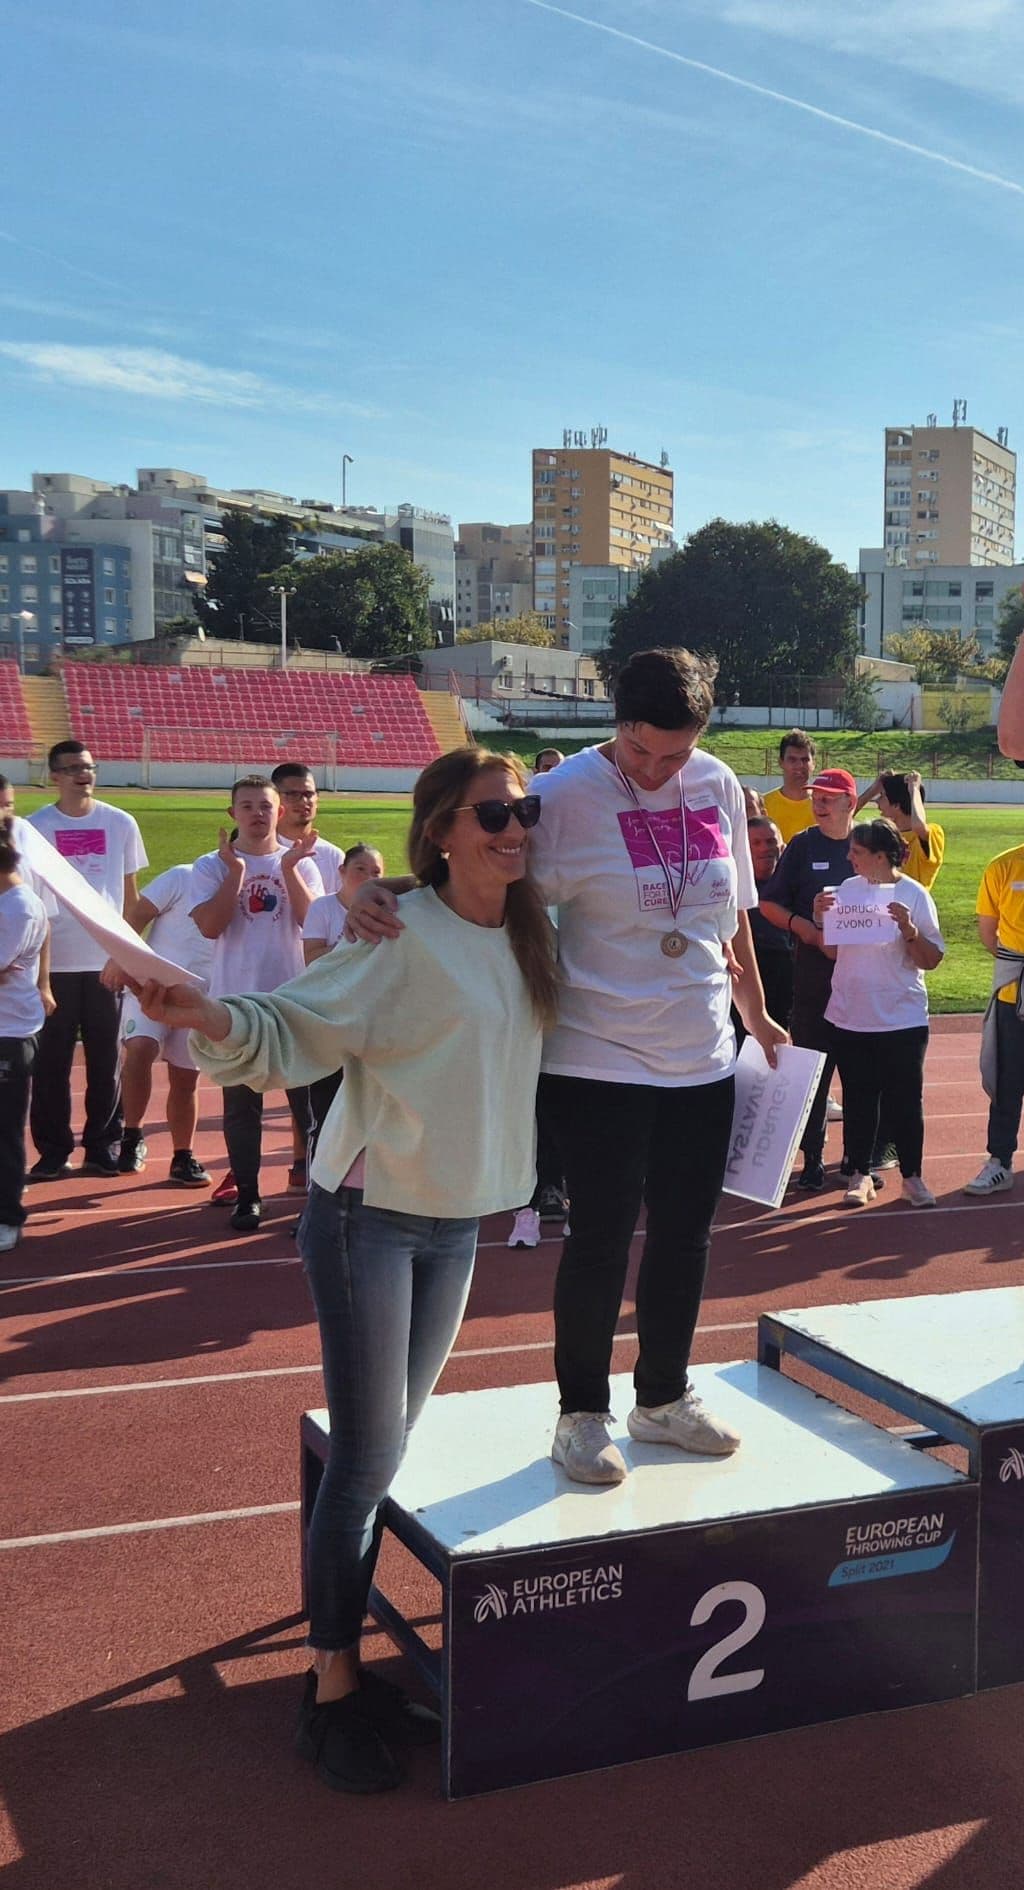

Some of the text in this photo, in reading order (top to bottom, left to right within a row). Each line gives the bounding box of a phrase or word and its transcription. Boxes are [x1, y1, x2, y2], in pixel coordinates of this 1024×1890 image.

[836, 919, 873, 929] ZVONO
[837, 904, 880, 915] UDRUGA
[845, 1511, 945, 1543] EUROPEAN
[845, 1530, 942, 1556] THROWING CUP
[512, 1563, 623, 1597] EUROPEAN
[841, 1559, 896, 1579] Split 2021
[511, 1581, 623, 1616] ATHLETICS
[688, 1580, 767, 1702] 2
